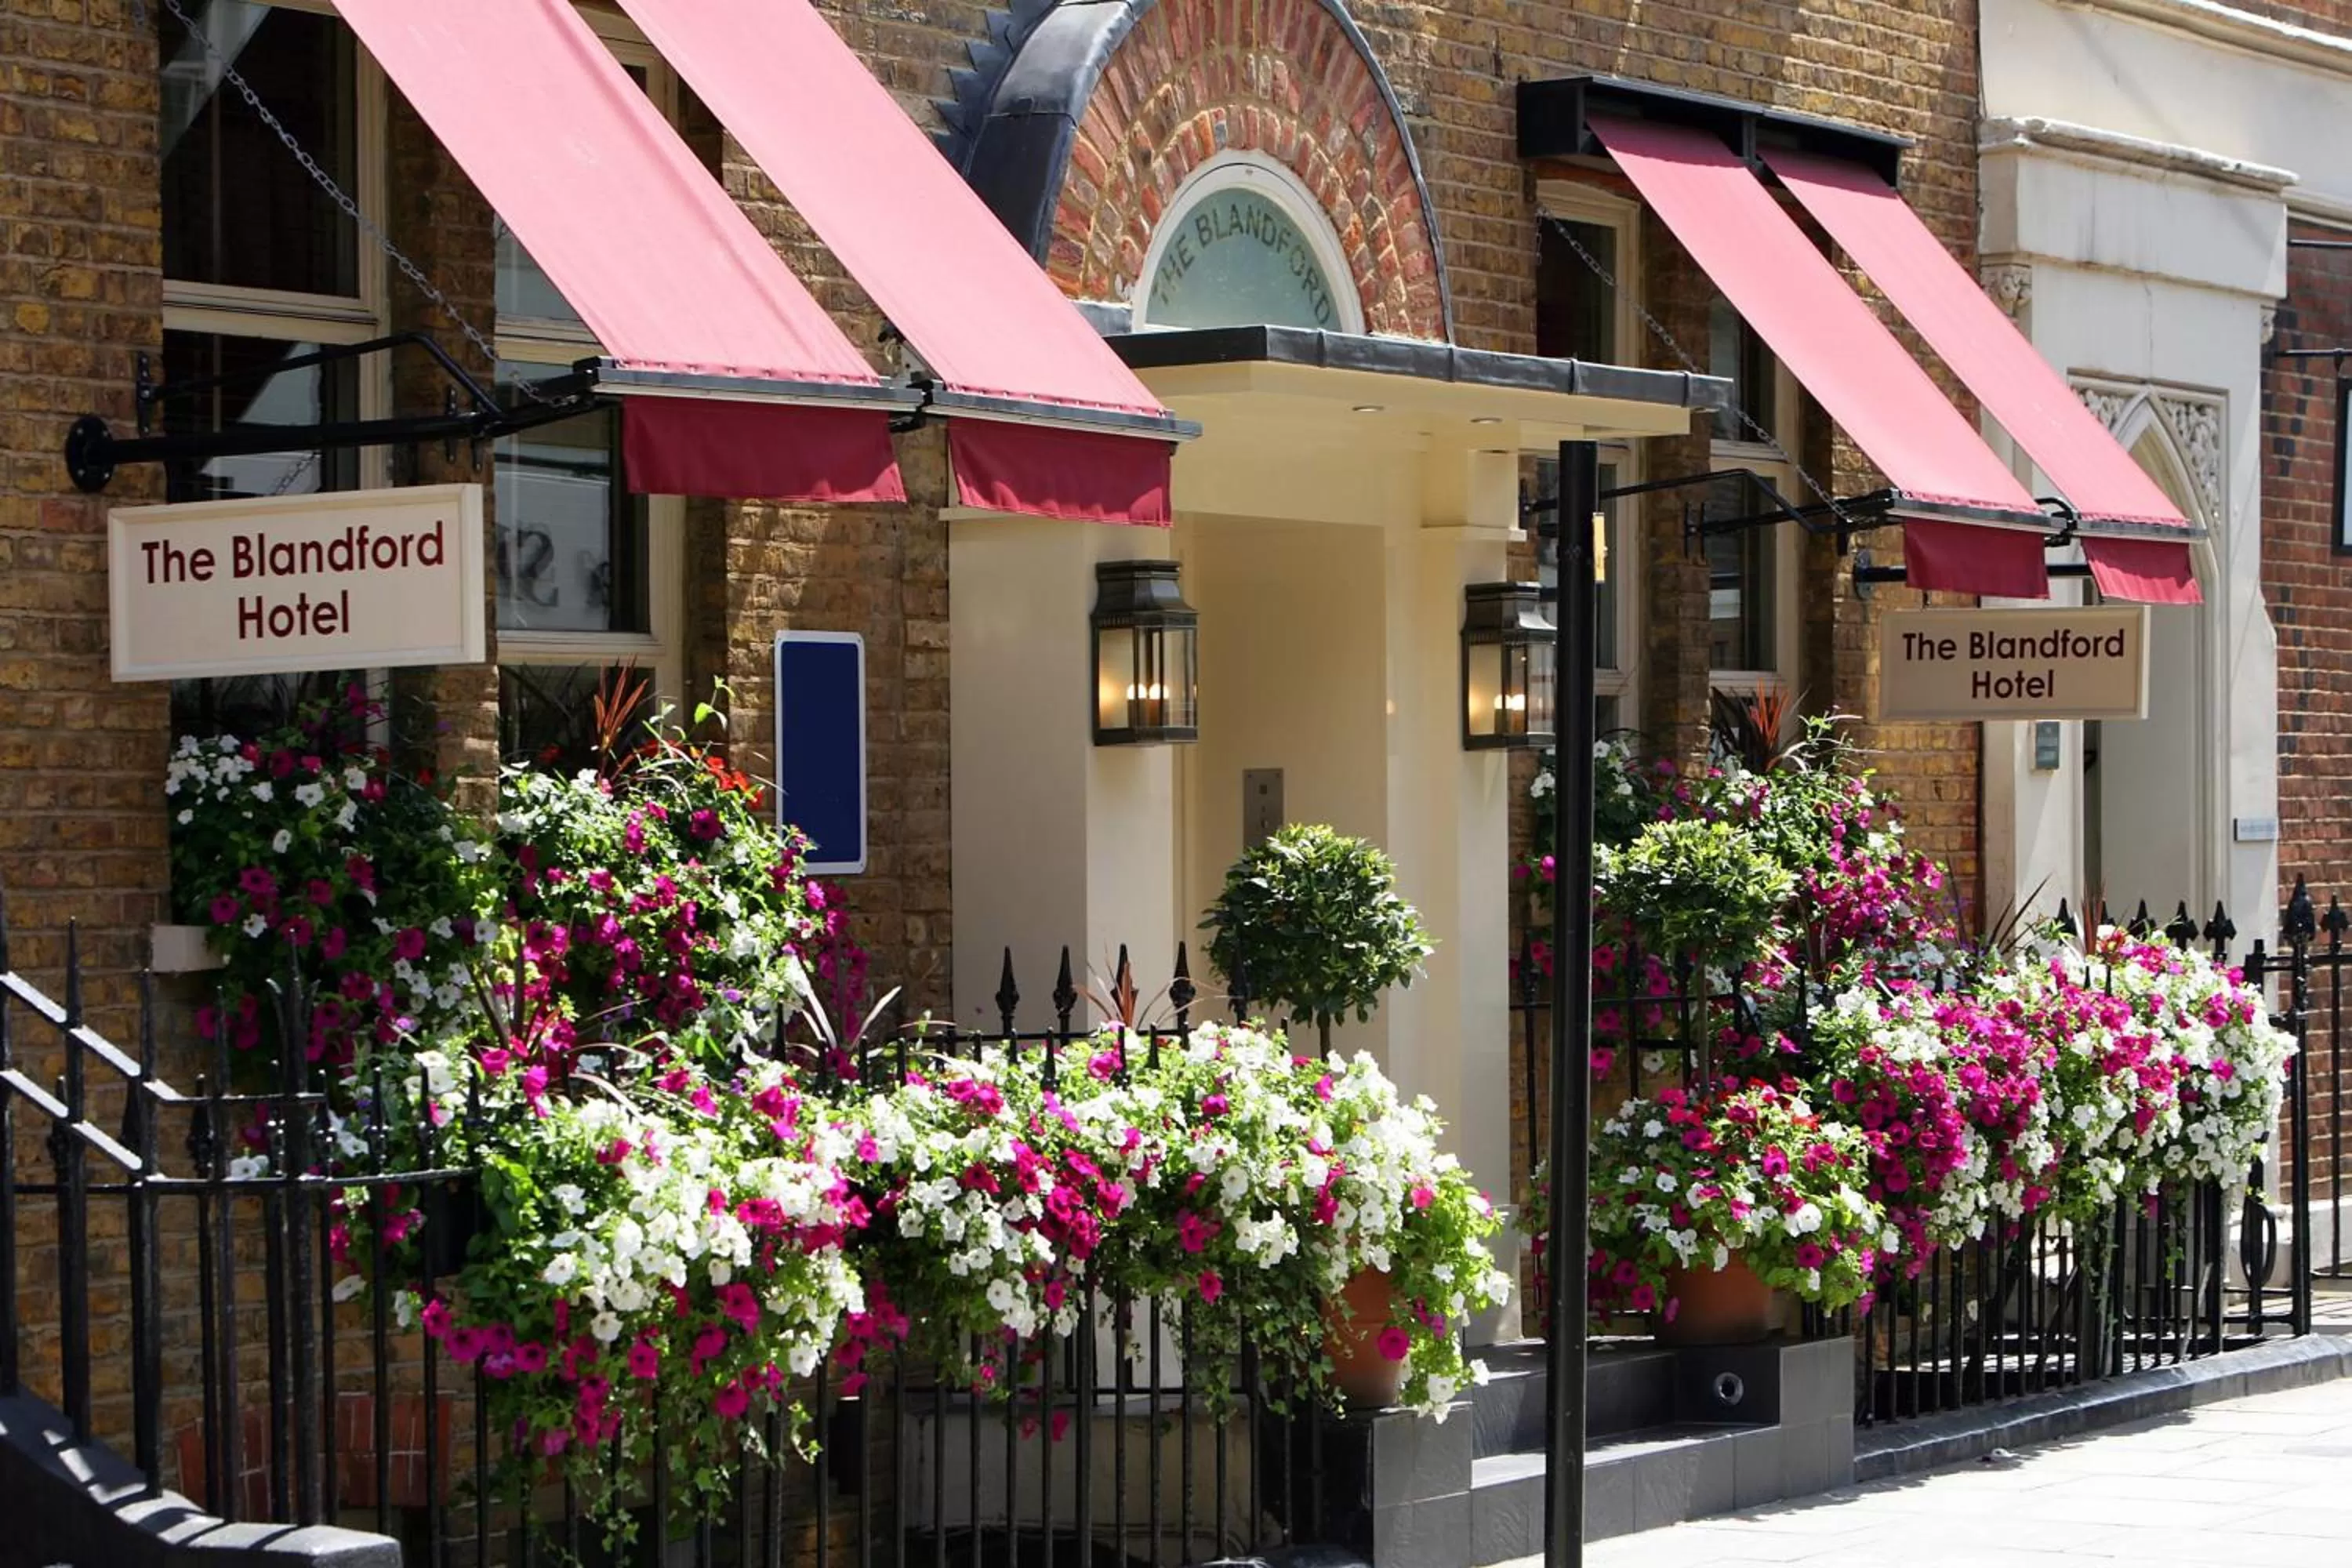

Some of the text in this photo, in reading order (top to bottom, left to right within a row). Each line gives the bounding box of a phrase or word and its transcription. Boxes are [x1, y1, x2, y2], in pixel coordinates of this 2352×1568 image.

[1152, 203, 1331, 325] THE BLANDFORD
[141, 539, 216, 584] The
[232, 521, 444, 579] Blandford
[238, 590, 350, 640] Hotel
[1902, 629, 2125, 661] The Blandford
[1971, 670, 2054, 699] Hotel
